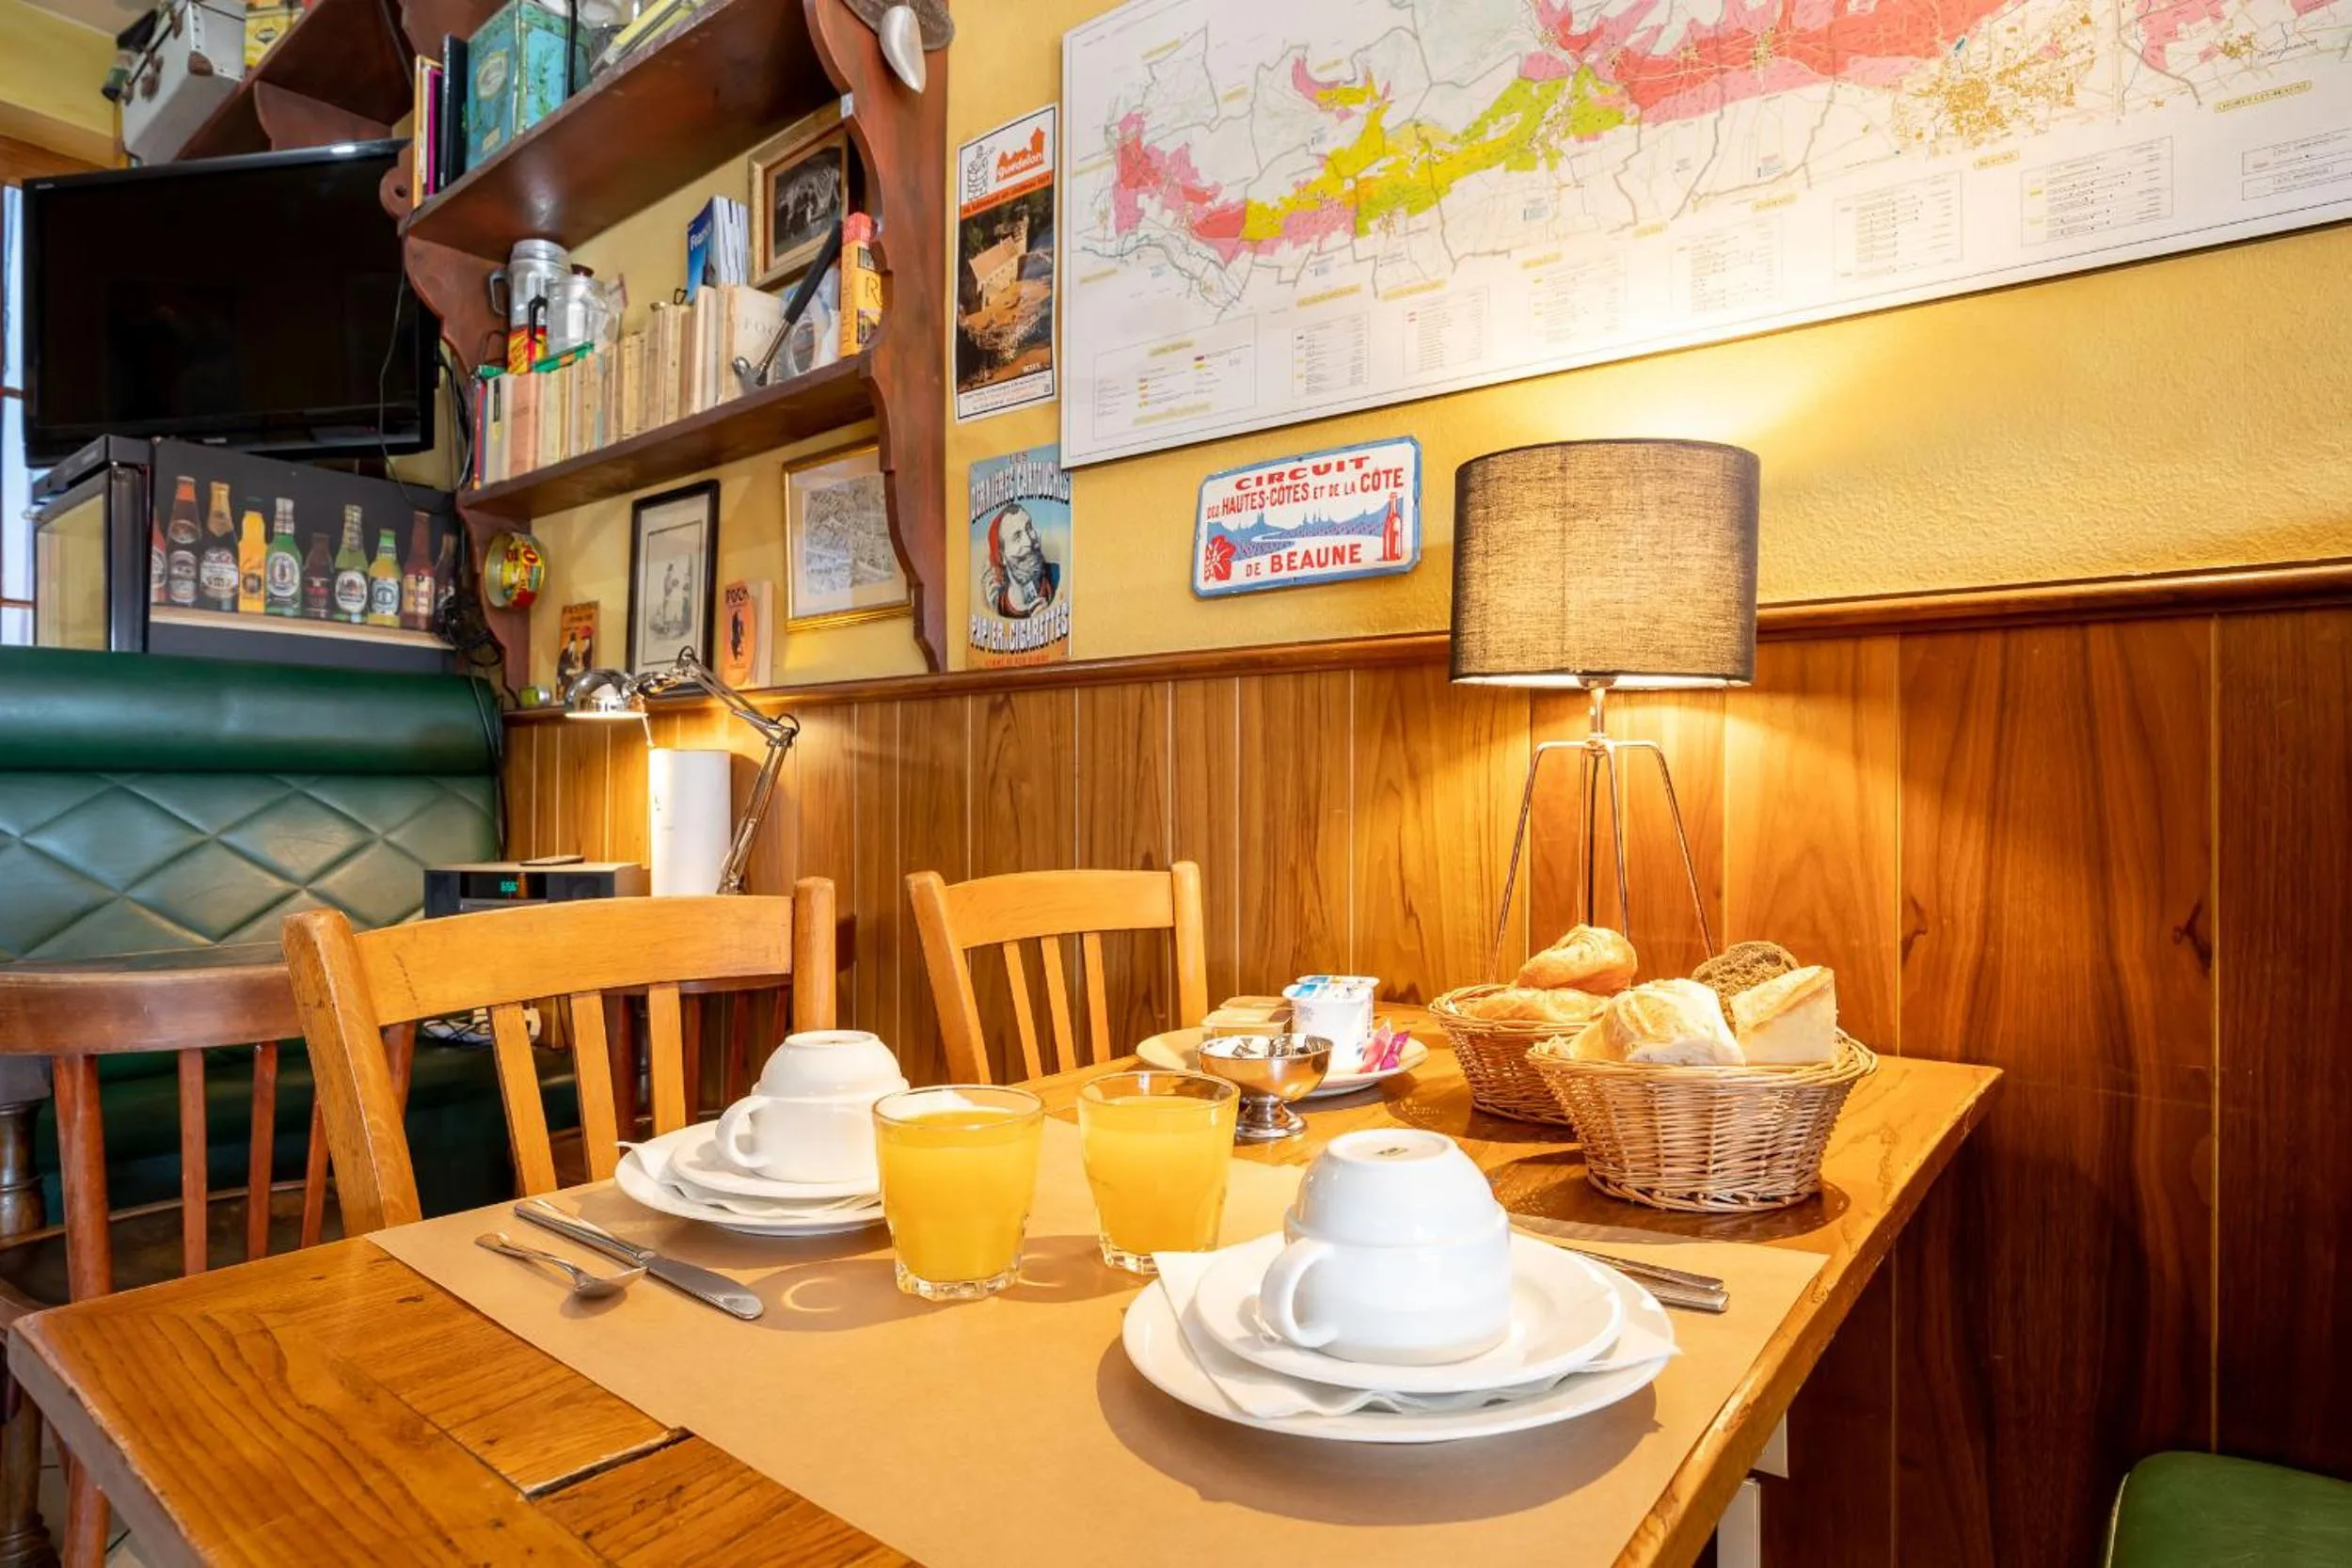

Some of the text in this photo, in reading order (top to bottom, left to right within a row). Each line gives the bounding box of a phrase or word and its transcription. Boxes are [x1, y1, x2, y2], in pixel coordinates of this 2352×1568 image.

[1234, 455, 1371, 491] CIRCUIT
[1313, 485, 1325, 499] ET
[1329, 483, 1340, 497] DE
[1344, 481, 1356, 495] LA
[1246, 544, 1362, 578] DE BEAUNE
